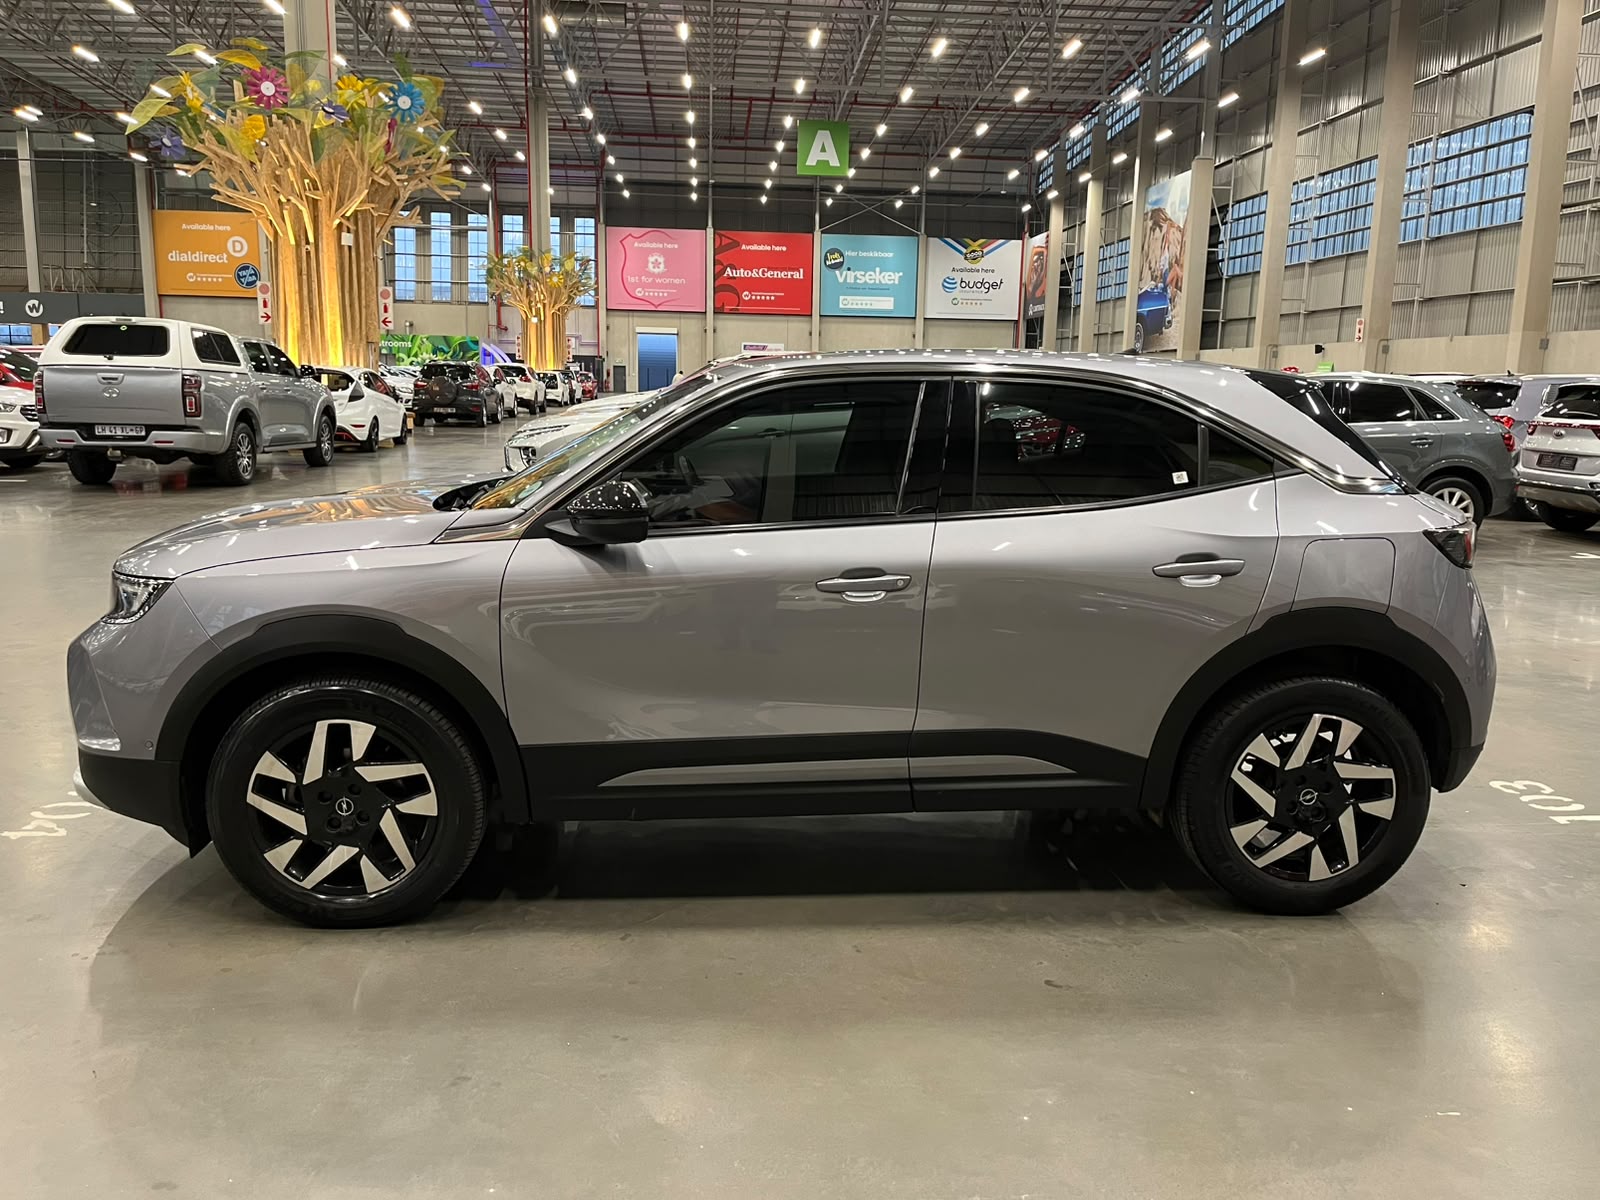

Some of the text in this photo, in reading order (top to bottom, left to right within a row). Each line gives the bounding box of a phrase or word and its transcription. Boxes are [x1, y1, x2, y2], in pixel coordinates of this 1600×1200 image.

[805, 129, 840, 167] A
[182, 223, 231, 232] Available here
[633, 241, 678, 250] Available here
[741, 243, 787, 252] Available here
[168, 250, 229, 264] dialdirect
[858, 250, 894, 258] beskikbaar
[627, 275, 686, 285] 1st for women
[724, 266, 804, 280] Auto&General
[835, 266, 903, 285] virseker
[960, 277, 1004, 294] budget
[1489, 779, 1600, 825] 103
